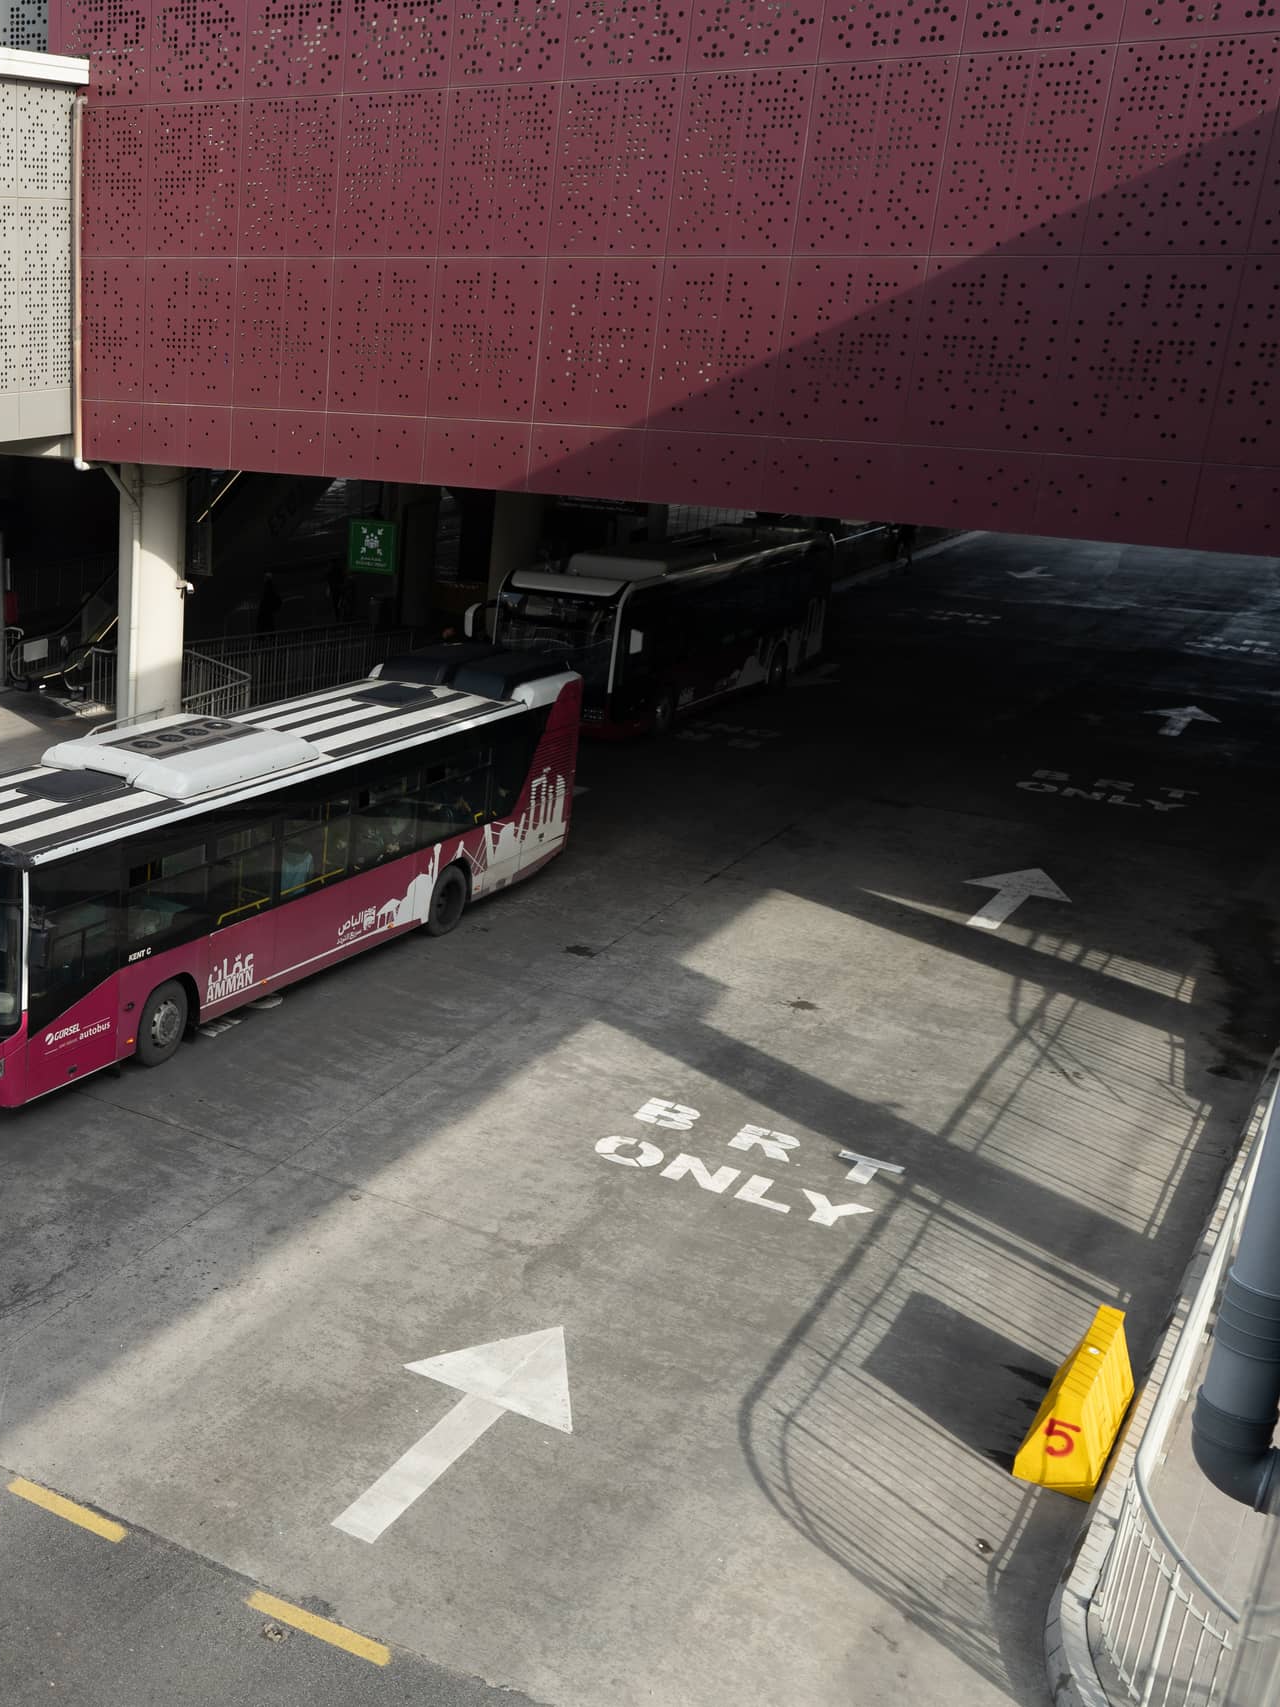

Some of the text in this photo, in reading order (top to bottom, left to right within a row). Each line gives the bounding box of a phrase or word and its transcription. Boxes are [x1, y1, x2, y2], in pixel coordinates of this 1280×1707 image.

[1016, 781, 1192, 812] ONLY
[337, 911, 364, 936] الباص
[128, 947, 152, 963] KENT C
[206, 967, 254, 1003] AMMAN
[79, 1021, 111, 1041] autobus
[594, 1135, 875, 1227] ONLY
[1044, 1417, 1082, 1457] 5
